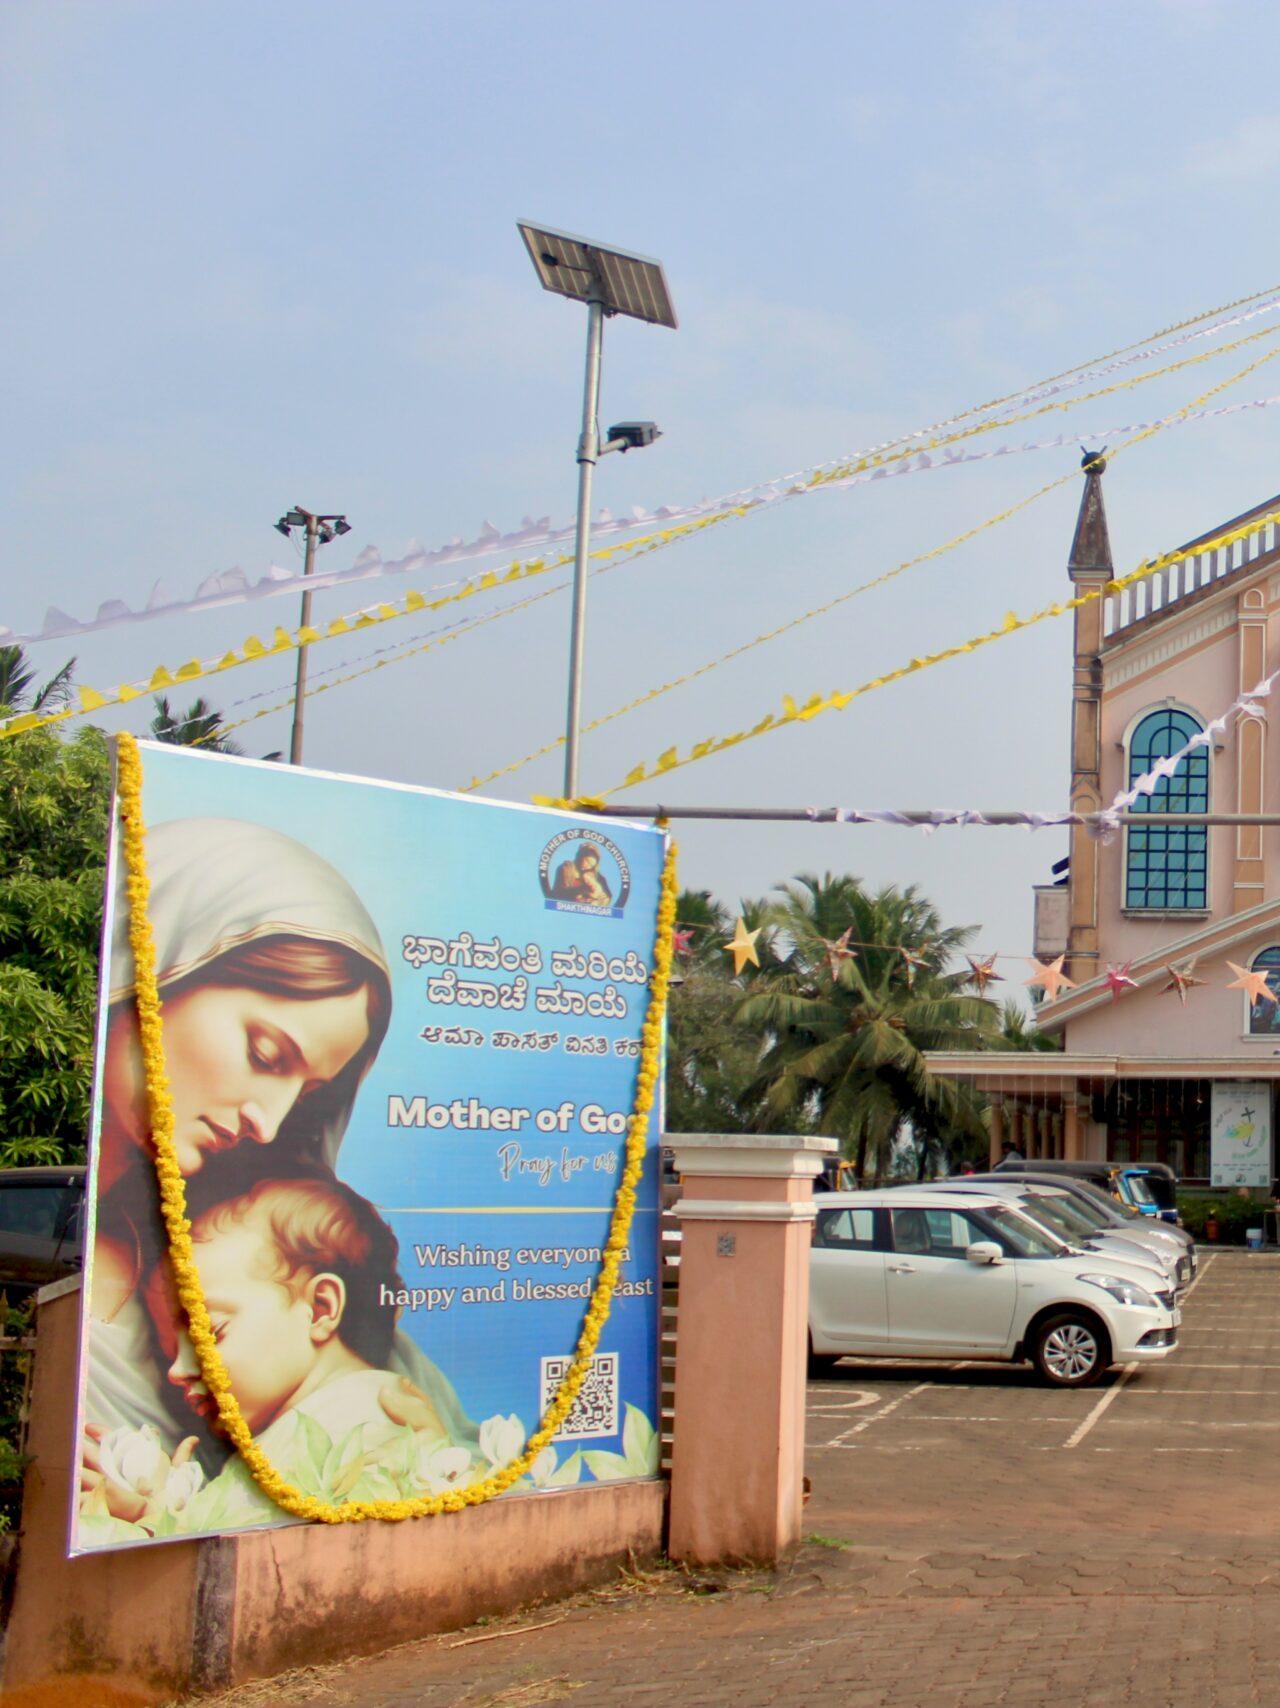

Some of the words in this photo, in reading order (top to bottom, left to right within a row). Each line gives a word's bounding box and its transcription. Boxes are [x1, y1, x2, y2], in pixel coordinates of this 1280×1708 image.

[540, 834, 566, 871] MOTHER
[567, 829, 580, 839] OF
[583, 830, 604, 843] GOD
[605, 841, 629, 882] CHURCH
[556, 902, 612, 916] SHAKTHINAGAR
[402, 932, 543, 974] ಭಾಗೆವಂತಿ
[535, 980, 627, 1019] ಮಾಯೆ
[388, 1095, 530, 1132] Mother
[536, 1101, 575, 1133] of
[579, 1103, 634, 1135] Go
[497, 1141, 556, 1186] Pray
[559, 1146, 589, 1182] for
[593, 1151, 617, 1174] us
[415, 1244, 510, 1271] Wishing
[516, 1246, 605, 1270] everyon
[380, 1284, 456, 1312] happy
[461, 1280, 506, 1304] and
[511, 1276, 593, 1300] blessed
[607, 1278, 654, 1297] east
